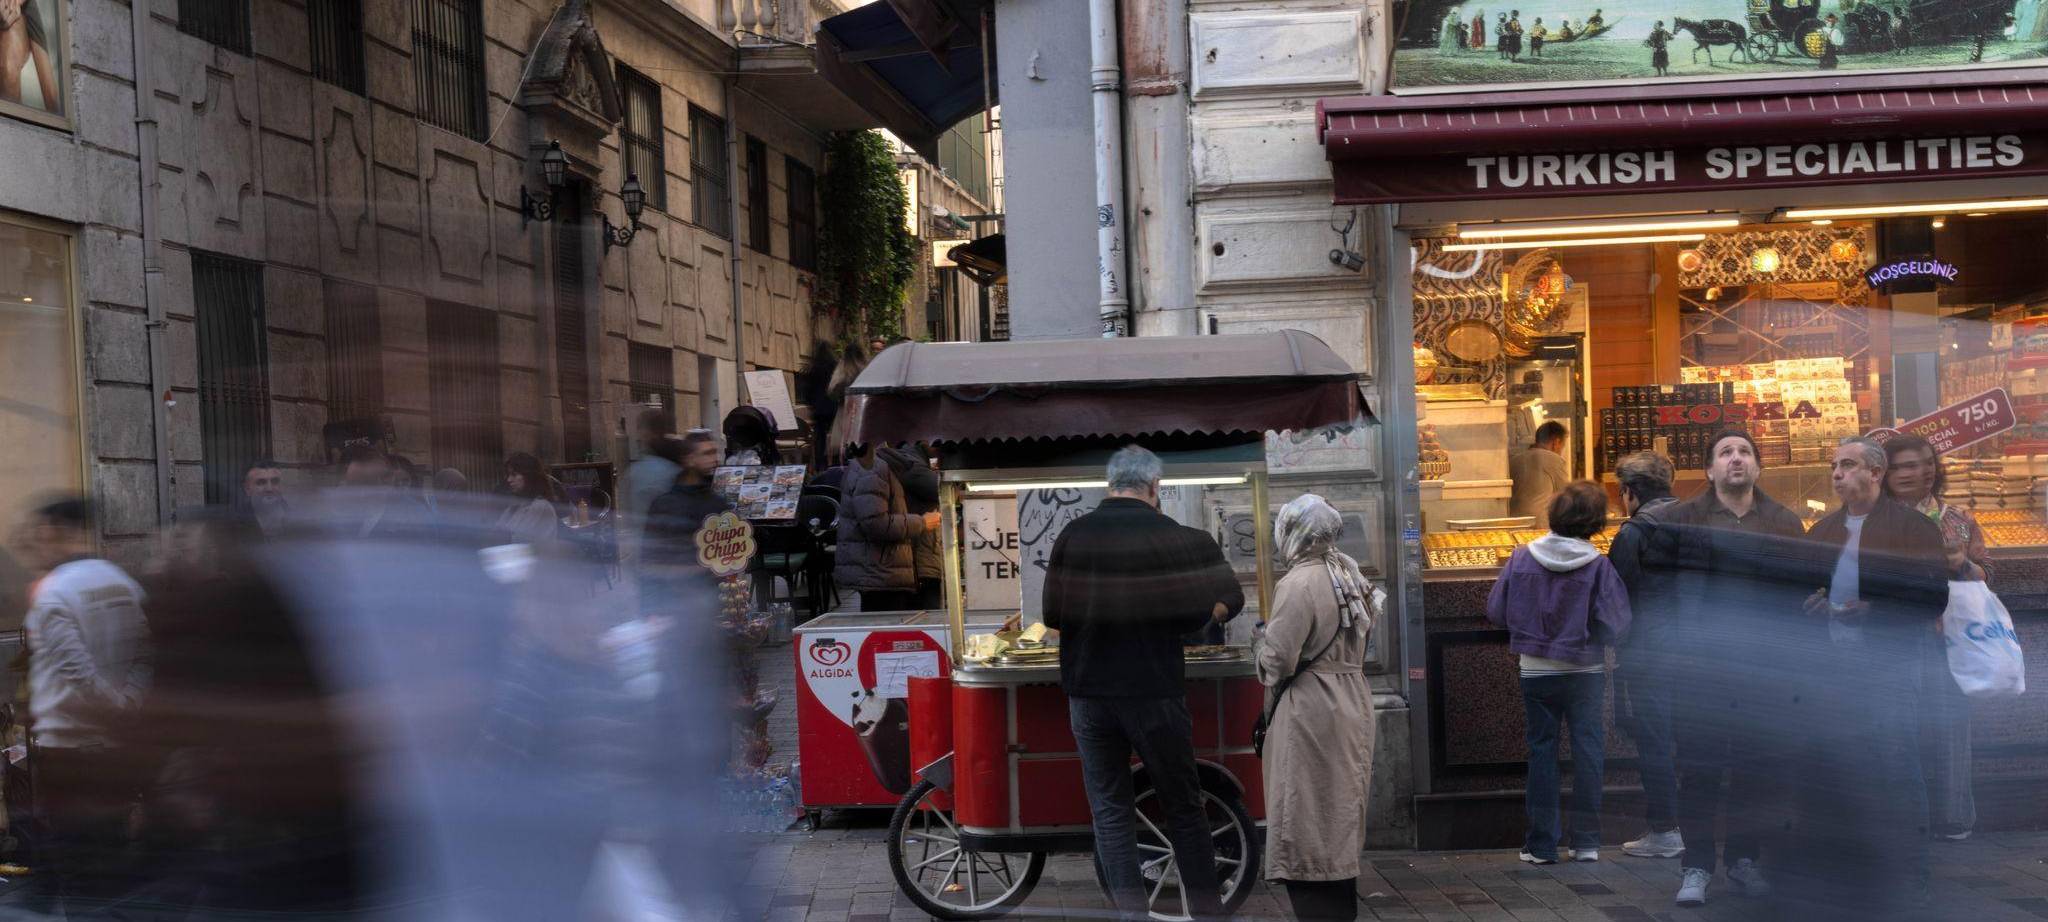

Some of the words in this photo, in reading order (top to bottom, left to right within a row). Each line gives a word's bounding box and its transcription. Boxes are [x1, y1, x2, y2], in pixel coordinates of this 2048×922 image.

[1467, 150, 1676, 189] TURKISH
[1704, 134, 2025, 179] SPECIALITIES
[1655, 400, 1823, 426] KOSKA
[1957, 398, 1999, 425] 750
[703, 526, 746, 544] Chupa
[704, 541, 747, 566] Chups
